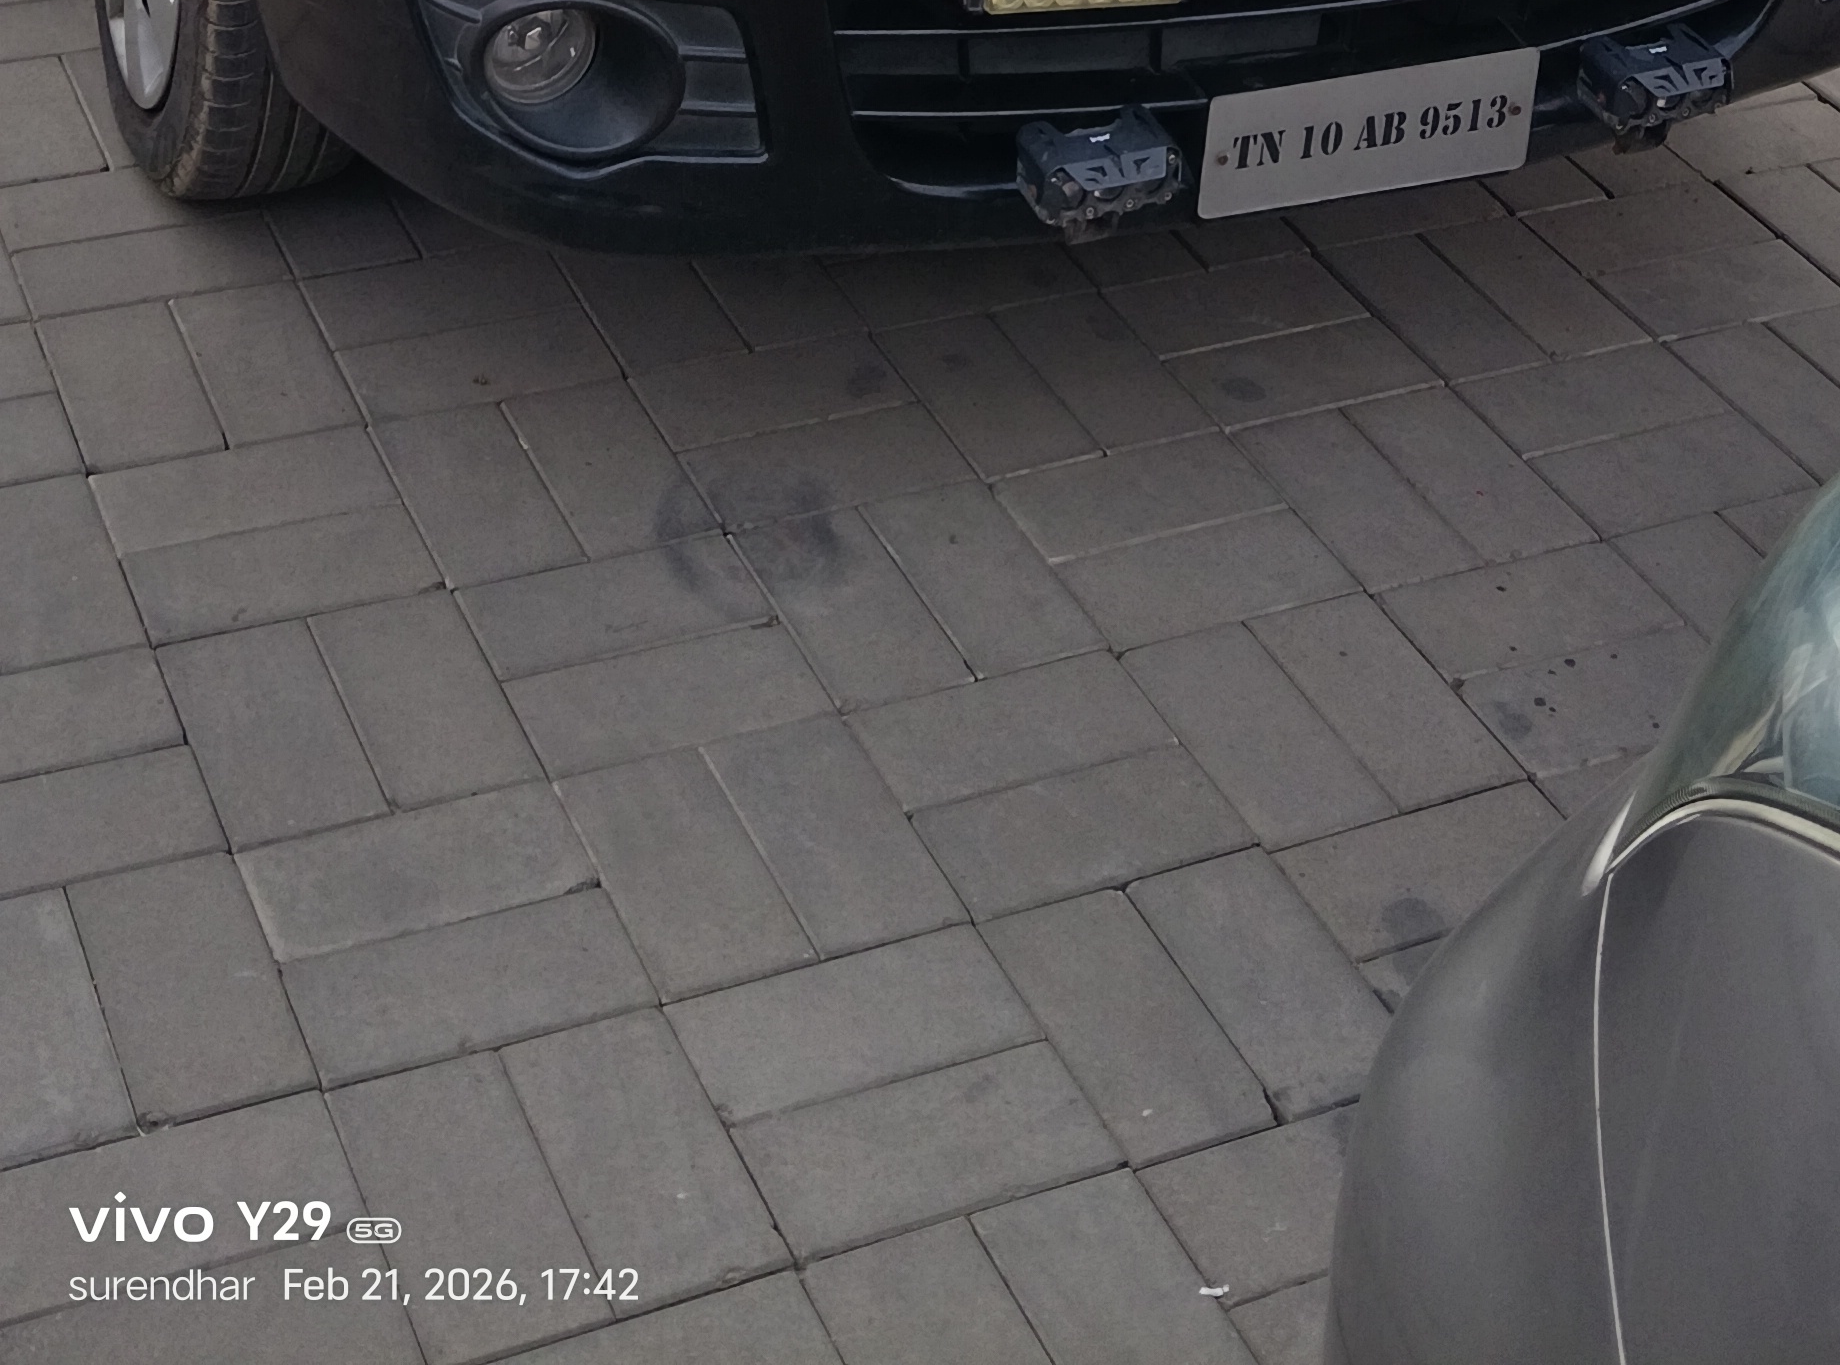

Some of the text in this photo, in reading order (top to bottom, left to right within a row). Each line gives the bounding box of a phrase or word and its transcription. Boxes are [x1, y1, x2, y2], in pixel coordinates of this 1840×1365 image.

[1232, 94, 1508, 170] TN 10 AB 9513
